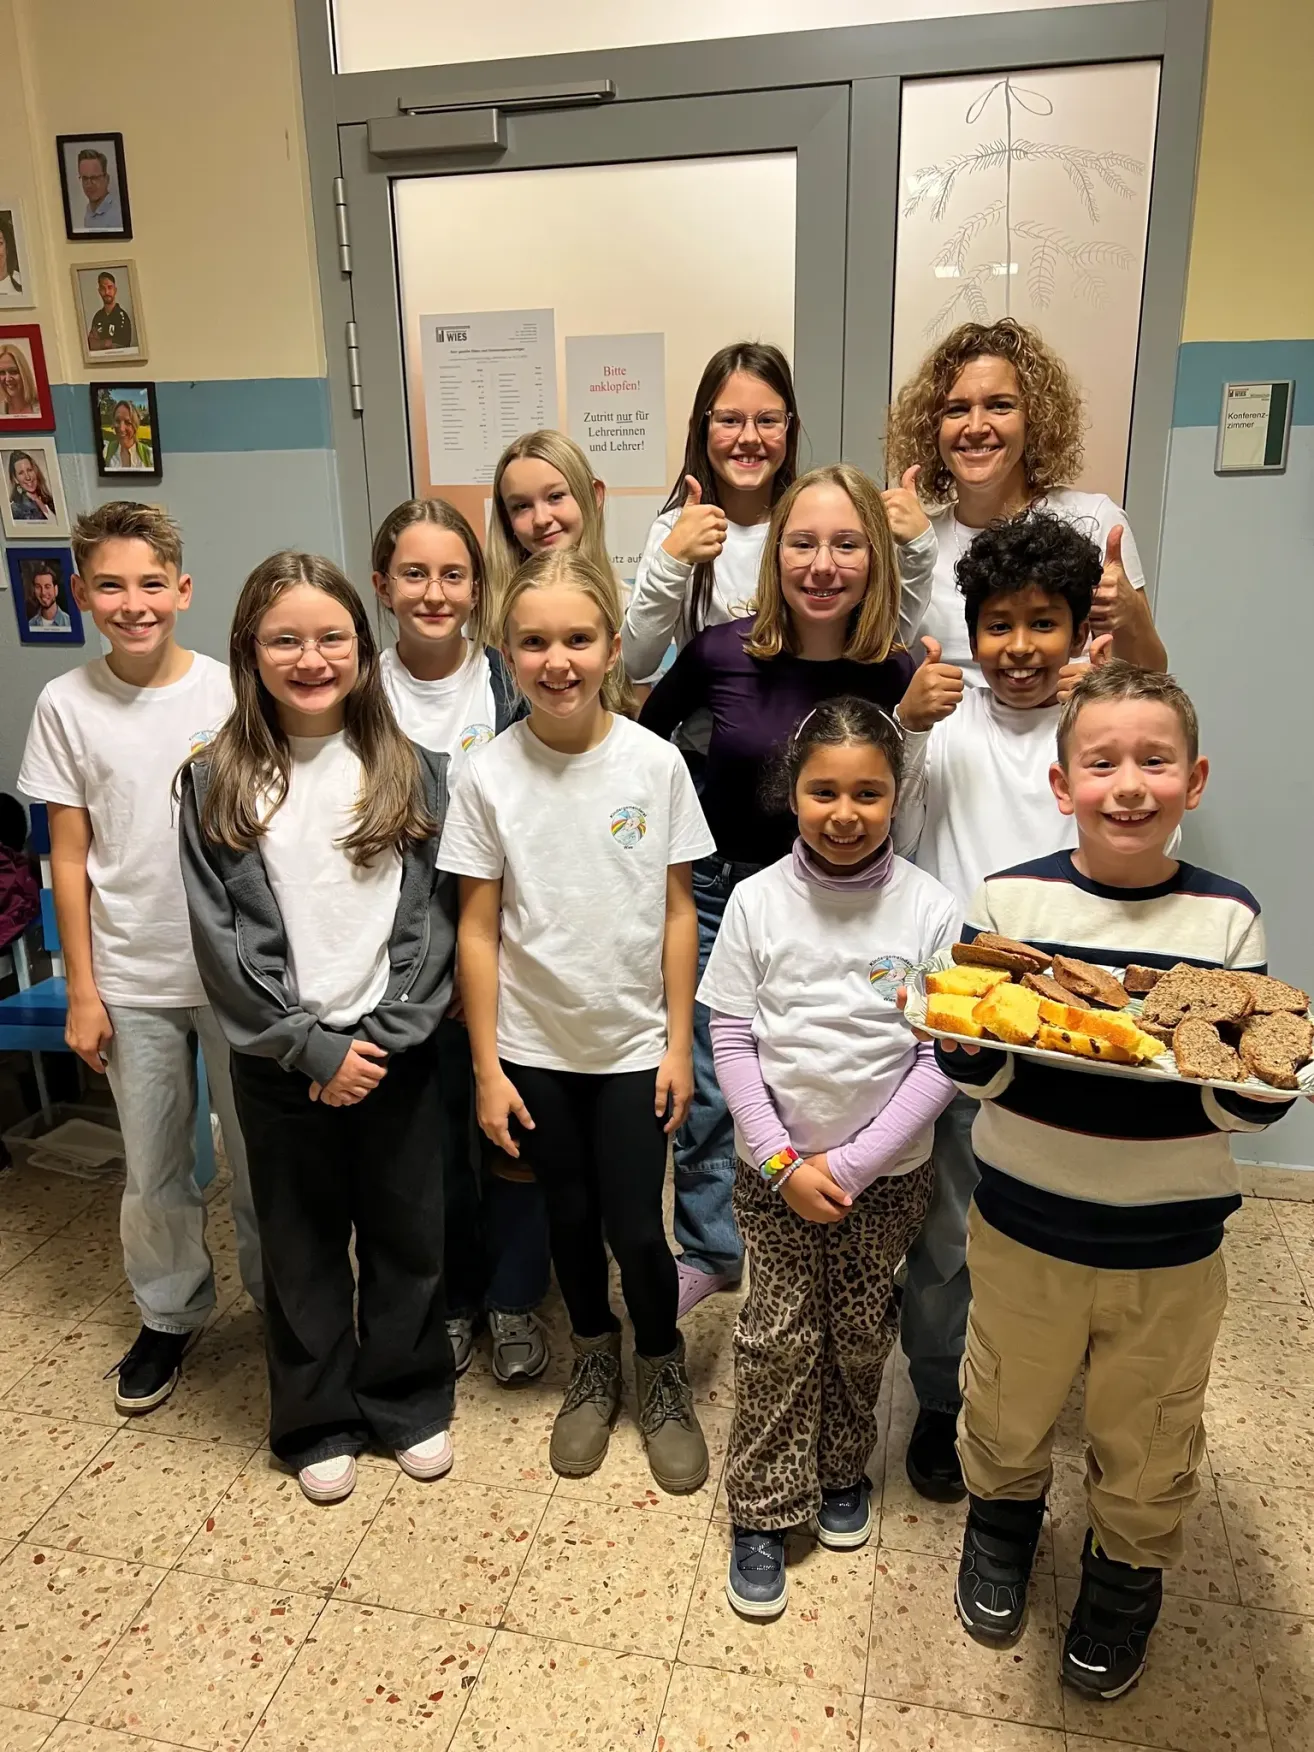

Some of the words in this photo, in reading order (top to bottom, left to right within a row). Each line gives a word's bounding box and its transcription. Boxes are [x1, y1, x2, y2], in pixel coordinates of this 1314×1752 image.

[446, 333, 467, 342] WIES
[603, 366, 627, 377] Bitte
[589, 380, 641, 394] anklopfen!
[583, 411, 614, 423] Zutritt
[616, 413, 633, 424] nur
[635, 411, 650, 421] für
[1227, 412, 1269, 420] Konferenz-
[588, 426, 646, 438] Lehrerinnen
[589, 441, 608, 452] und
[610, 440, 645, 452] Lehrer!
